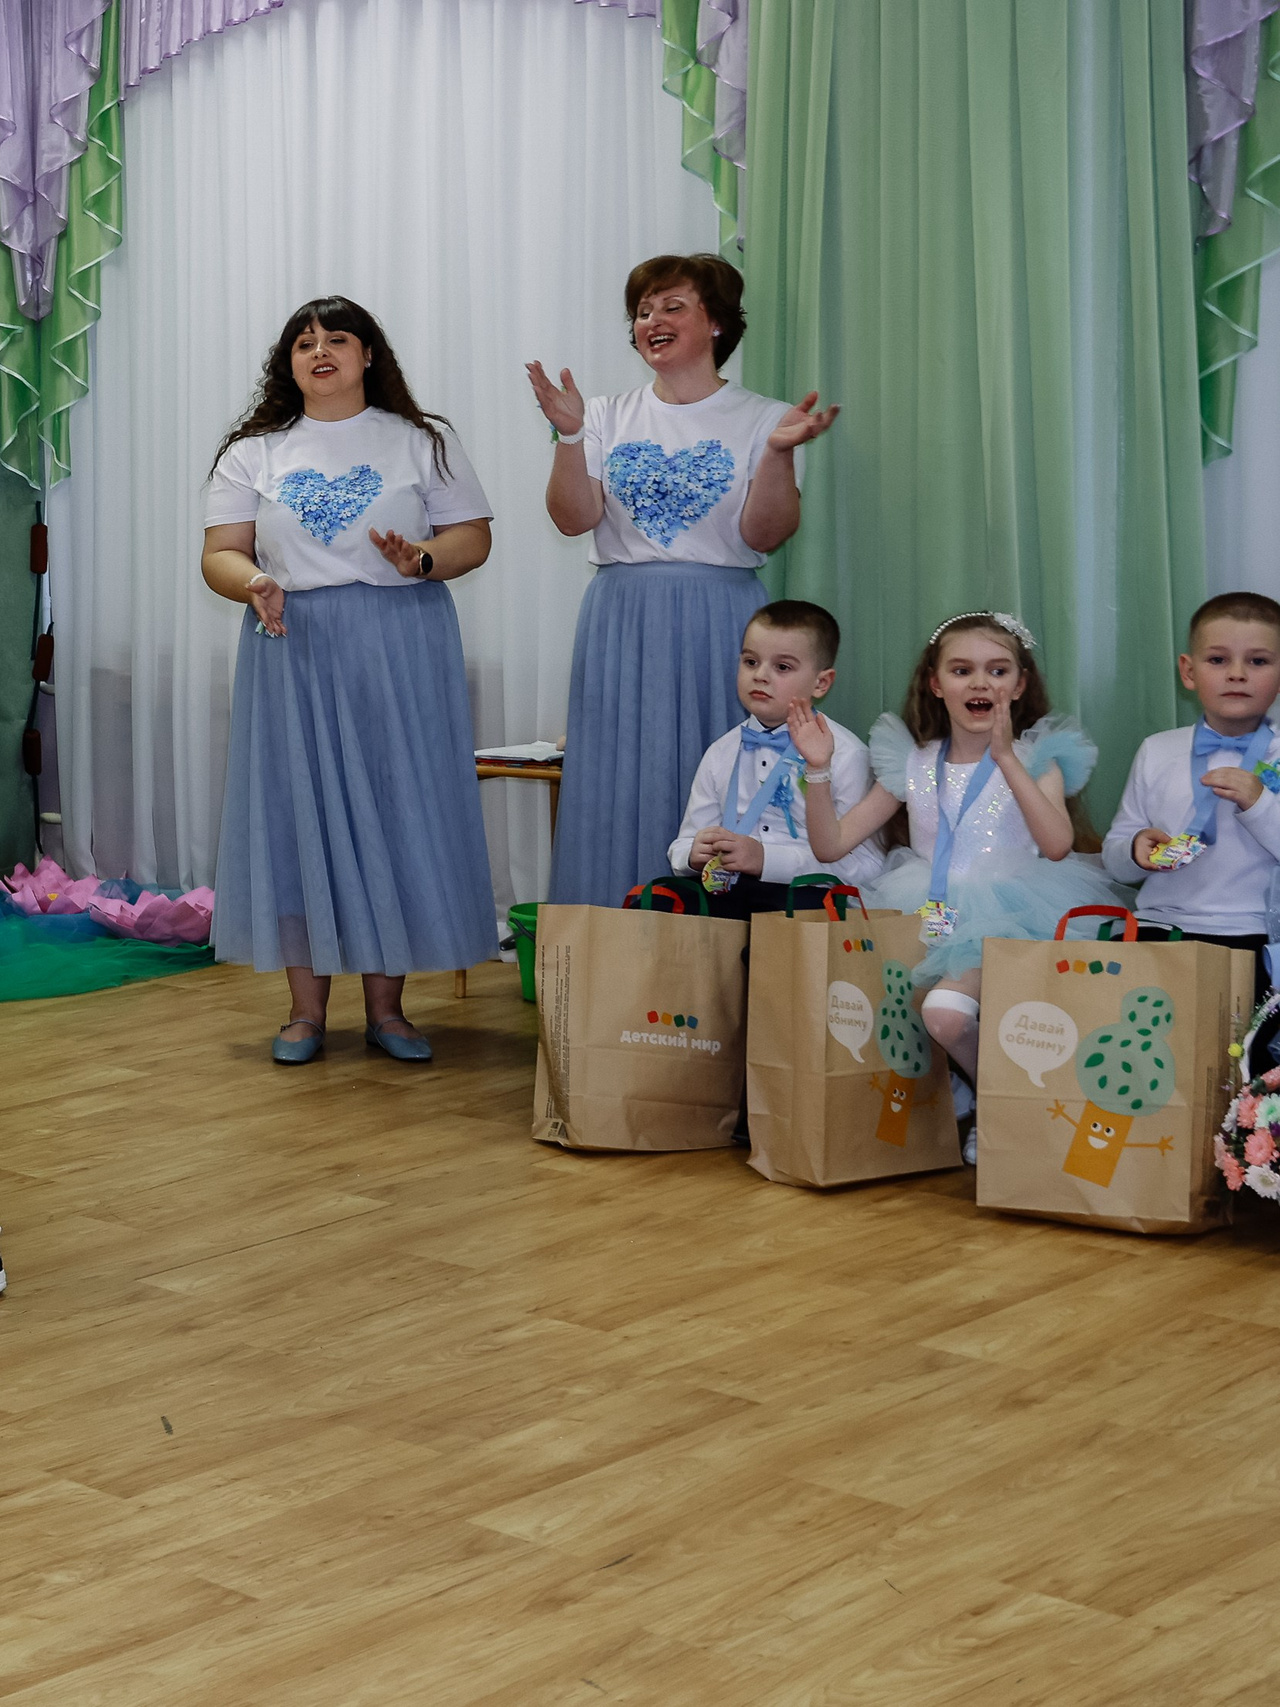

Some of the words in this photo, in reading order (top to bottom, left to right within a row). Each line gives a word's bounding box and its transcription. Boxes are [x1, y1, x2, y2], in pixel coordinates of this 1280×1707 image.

[831, 994, 864, 1011] Давай
[829, 1011, 868, 1031] обниму
[1014, 1014, 1065, 1035] Давай
[690, 1038, 722, 1056] мир
[1005, 1032, 1067, 1056] обниму
